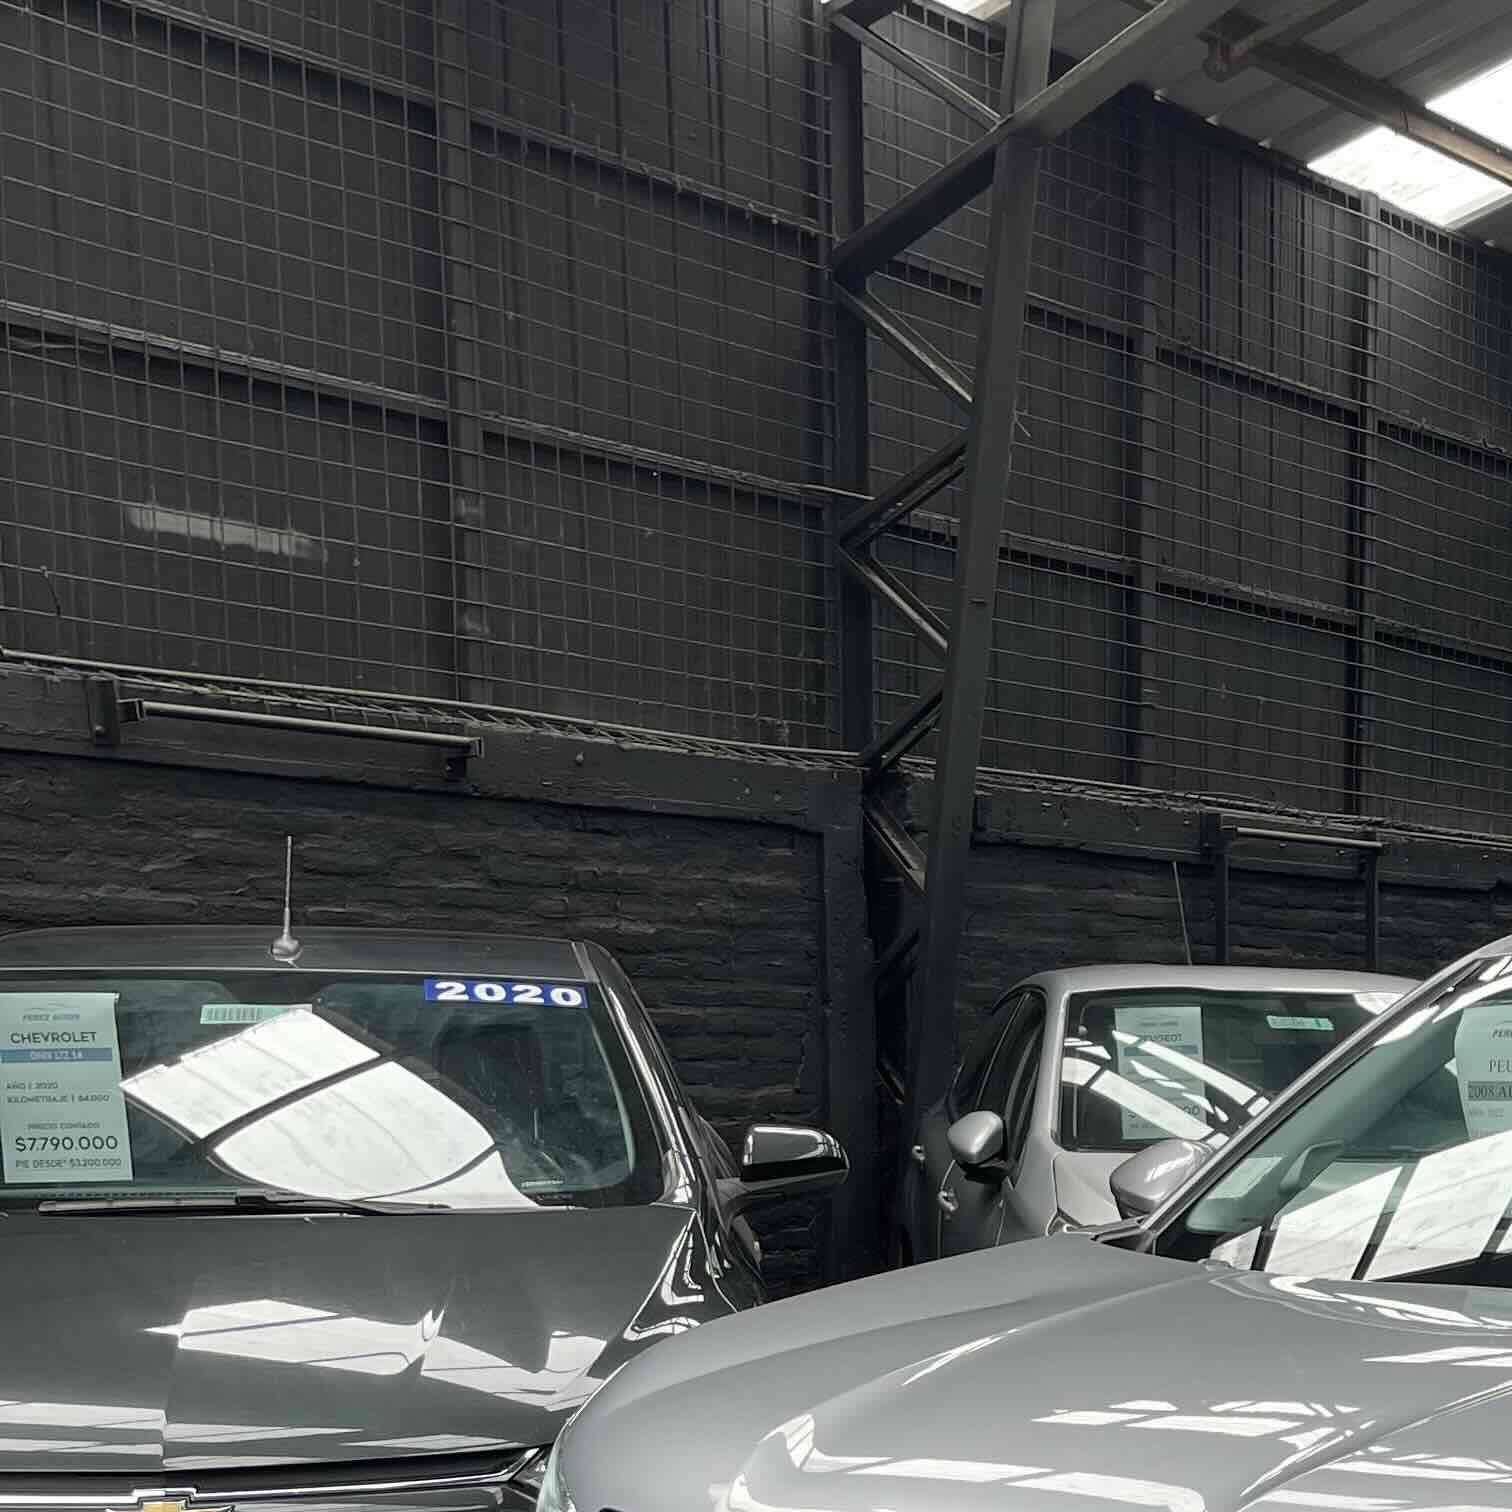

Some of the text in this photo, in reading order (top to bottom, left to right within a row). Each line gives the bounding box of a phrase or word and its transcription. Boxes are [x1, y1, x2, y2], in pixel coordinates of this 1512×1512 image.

[434, 981, 582, 1007] 2020
[10, 1031, 97, 1044] CHEVROLET
[1468, 1084, 1495, 1098] 2008
